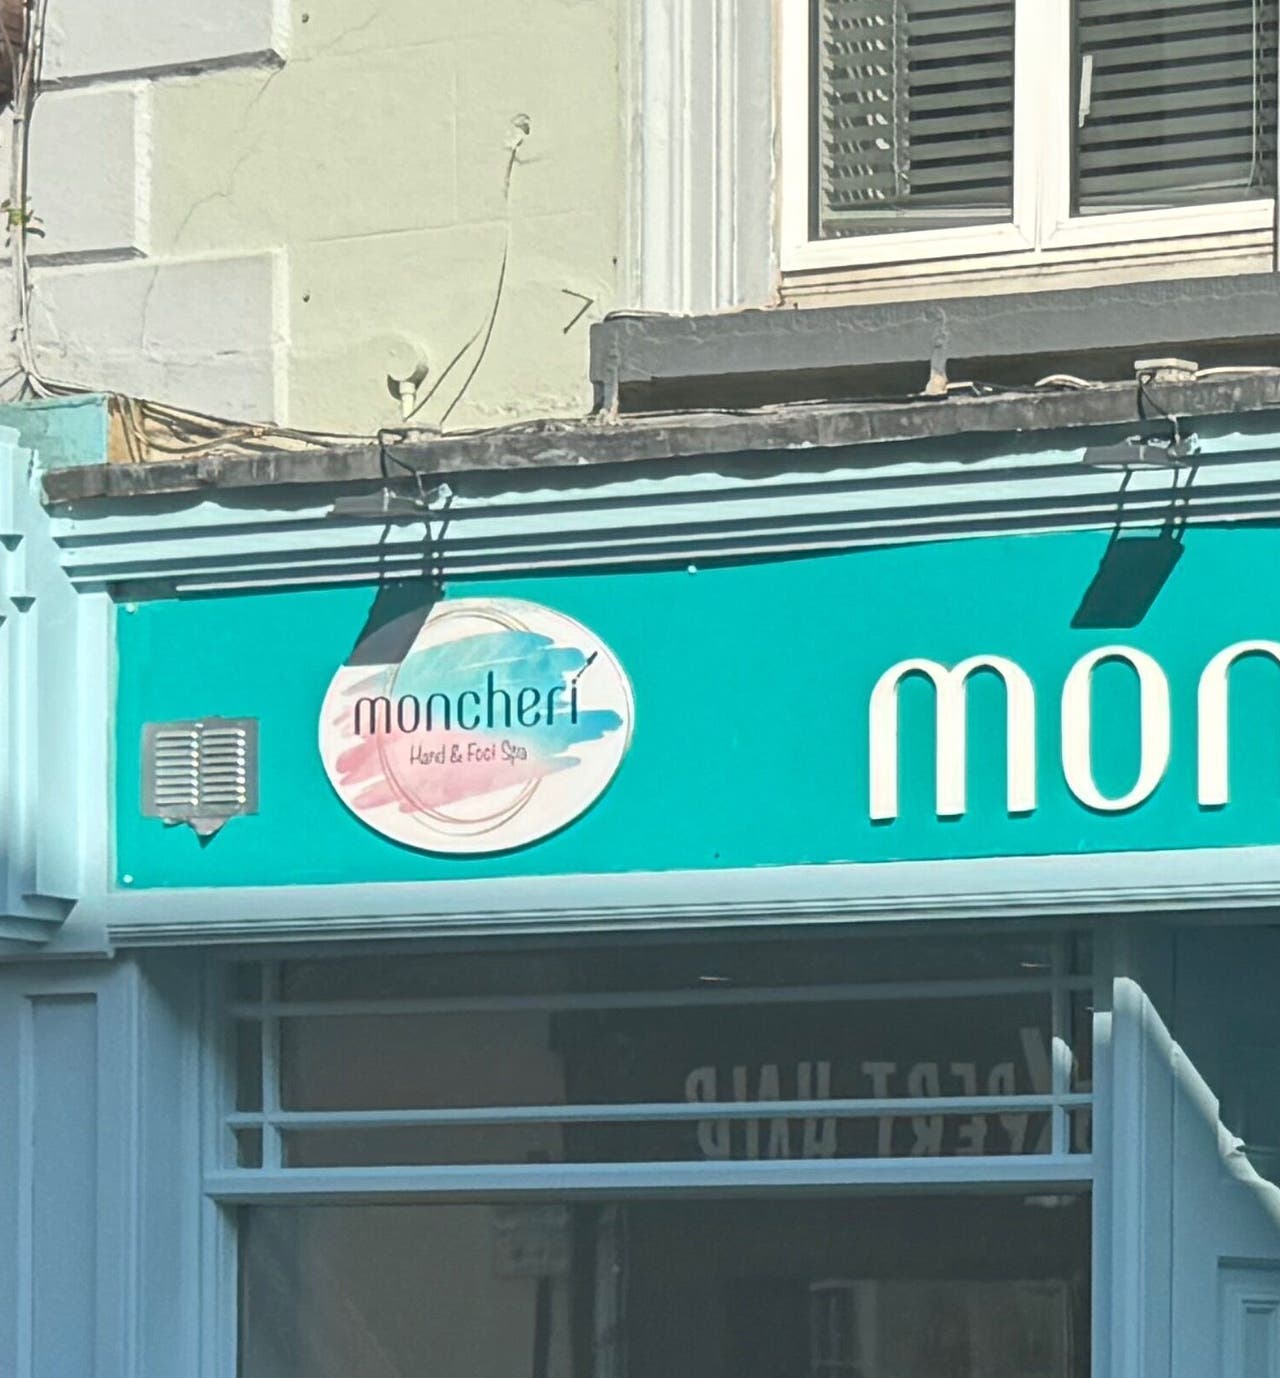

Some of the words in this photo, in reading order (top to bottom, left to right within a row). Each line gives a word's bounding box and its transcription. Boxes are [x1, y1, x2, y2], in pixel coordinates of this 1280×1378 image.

[354, 670, 579, 736] moncheri
[410, 743, 446, 766] Hand
[449, 744, 463, 764] &
[501, 739, 528, 767] Spa
